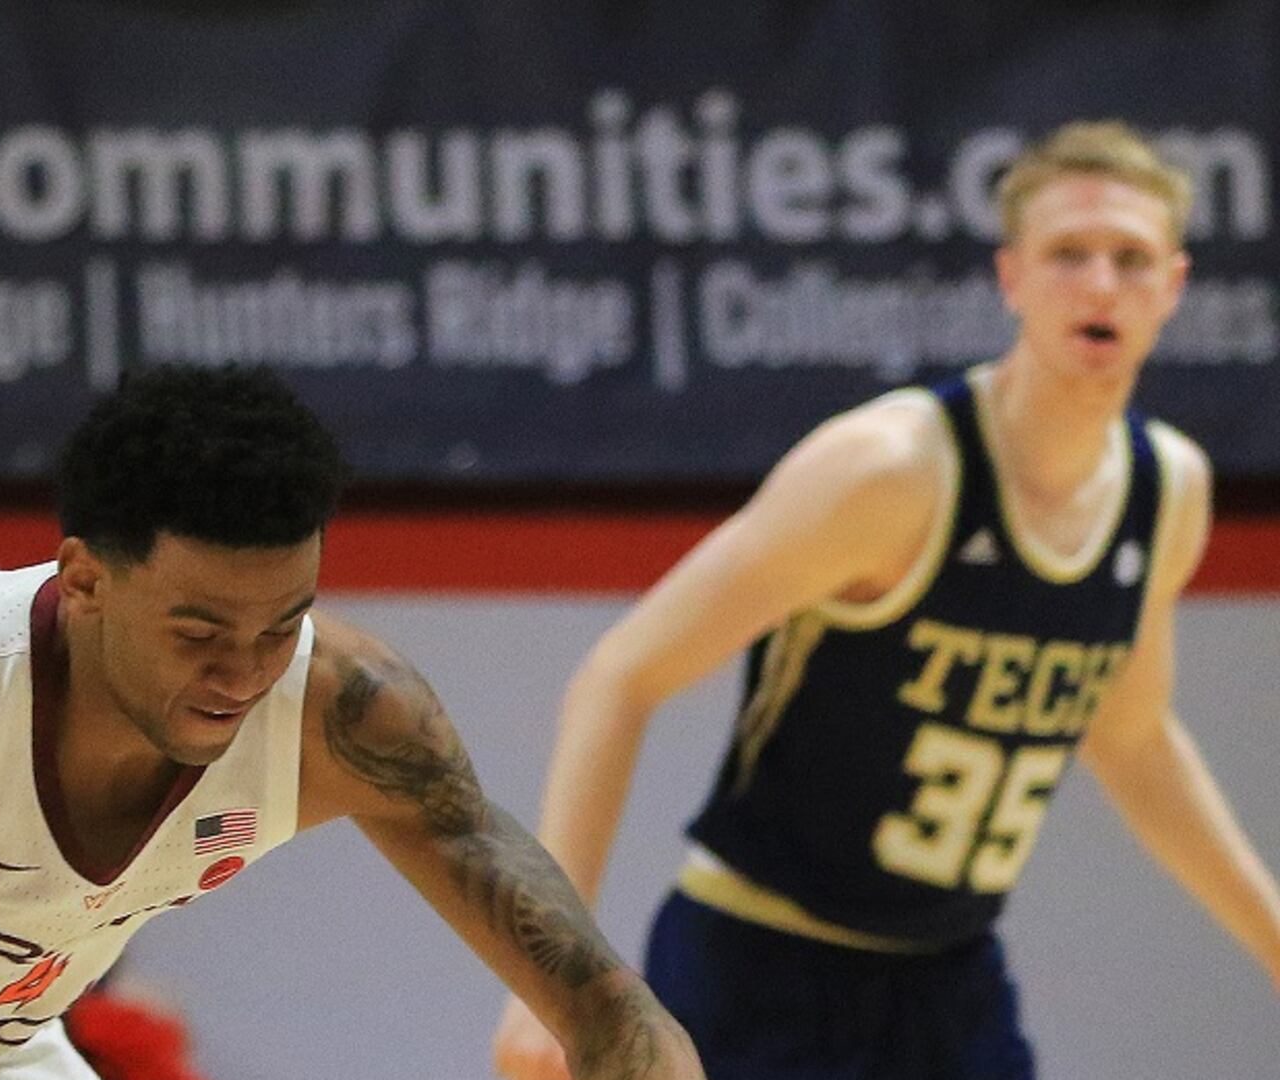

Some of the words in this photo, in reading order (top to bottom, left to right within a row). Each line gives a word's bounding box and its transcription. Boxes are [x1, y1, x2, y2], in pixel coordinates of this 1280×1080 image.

[134, 258, 420, 370] Hunters
[426, 258, 635, 384] Ridge
[872, 721, 1073, 894] 35
